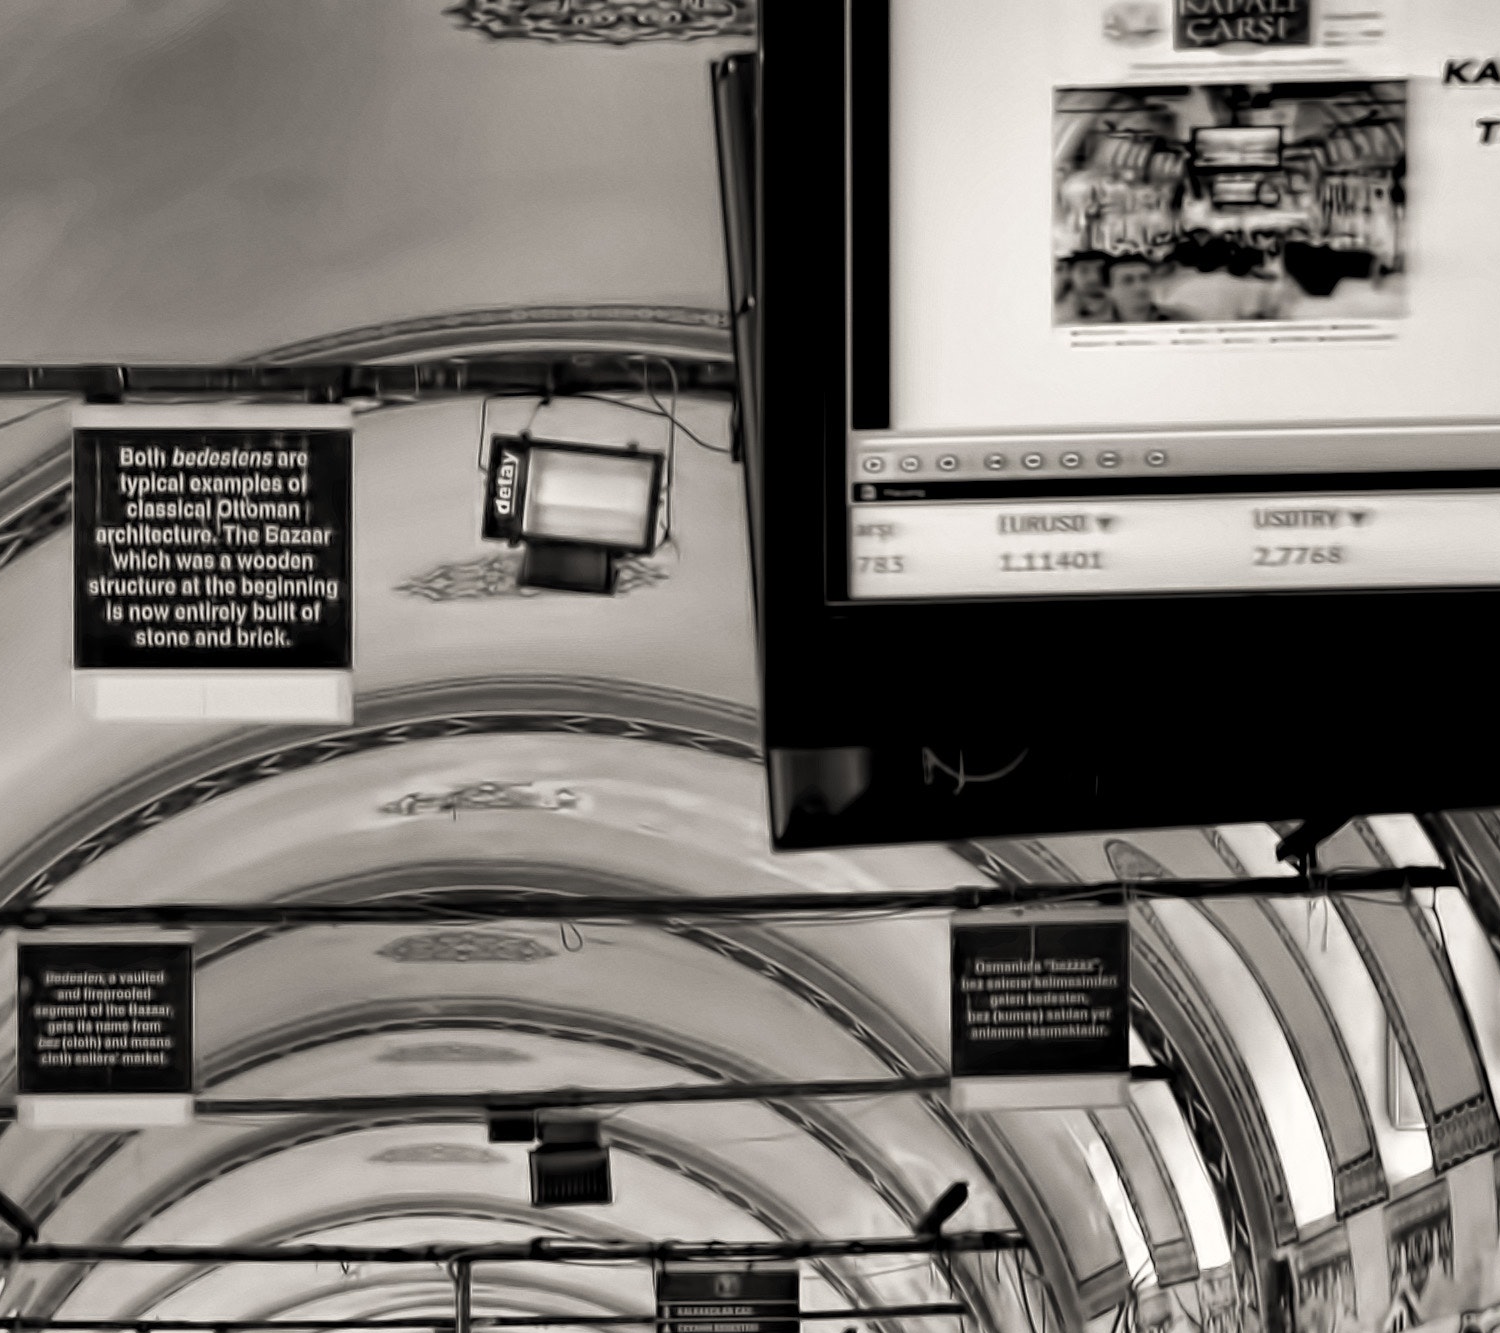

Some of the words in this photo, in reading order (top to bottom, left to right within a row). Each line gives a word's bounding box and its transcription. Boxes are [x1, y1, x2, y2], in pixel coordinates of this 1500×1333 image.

[120, 447, 165, 467] Both
[173, 447, 272, 467] bedestens
[278, 452, 307, 467] are
[120, 474, 184, 497] typical
[190, 474, 282, 497] examples
[289, 474, 307, 493] of
[127, 500, 211, 518] classical
[219, 500, 299, 518] Ottoman
[96, 525, 218, 545] architecture.
[223, 525, 258, 544] The
[265, 525, 331, 544] Bazaar
[112, 550, 170, 569] which
[176, 555, 213, 569] was
[220, 555, 231, 569] a
[237, 550, 313, 569] wooden
[89, 577, 176, 596] structure
[181, 578, 199, 596] at
[205, 577, 235, 596] the
[242, 577, 338, 598] beginning
[106, 602, 122, 620] is
[129, 606, 169, 620] now
[176, 602, 247, 624] entirely
[254, 602, 295, 620] built
[302, 602, 321, 621] of
[136, 629, 189, 646] stone
[195, 627, 230, 646] and
[237, 627, 291, 646] brick.
